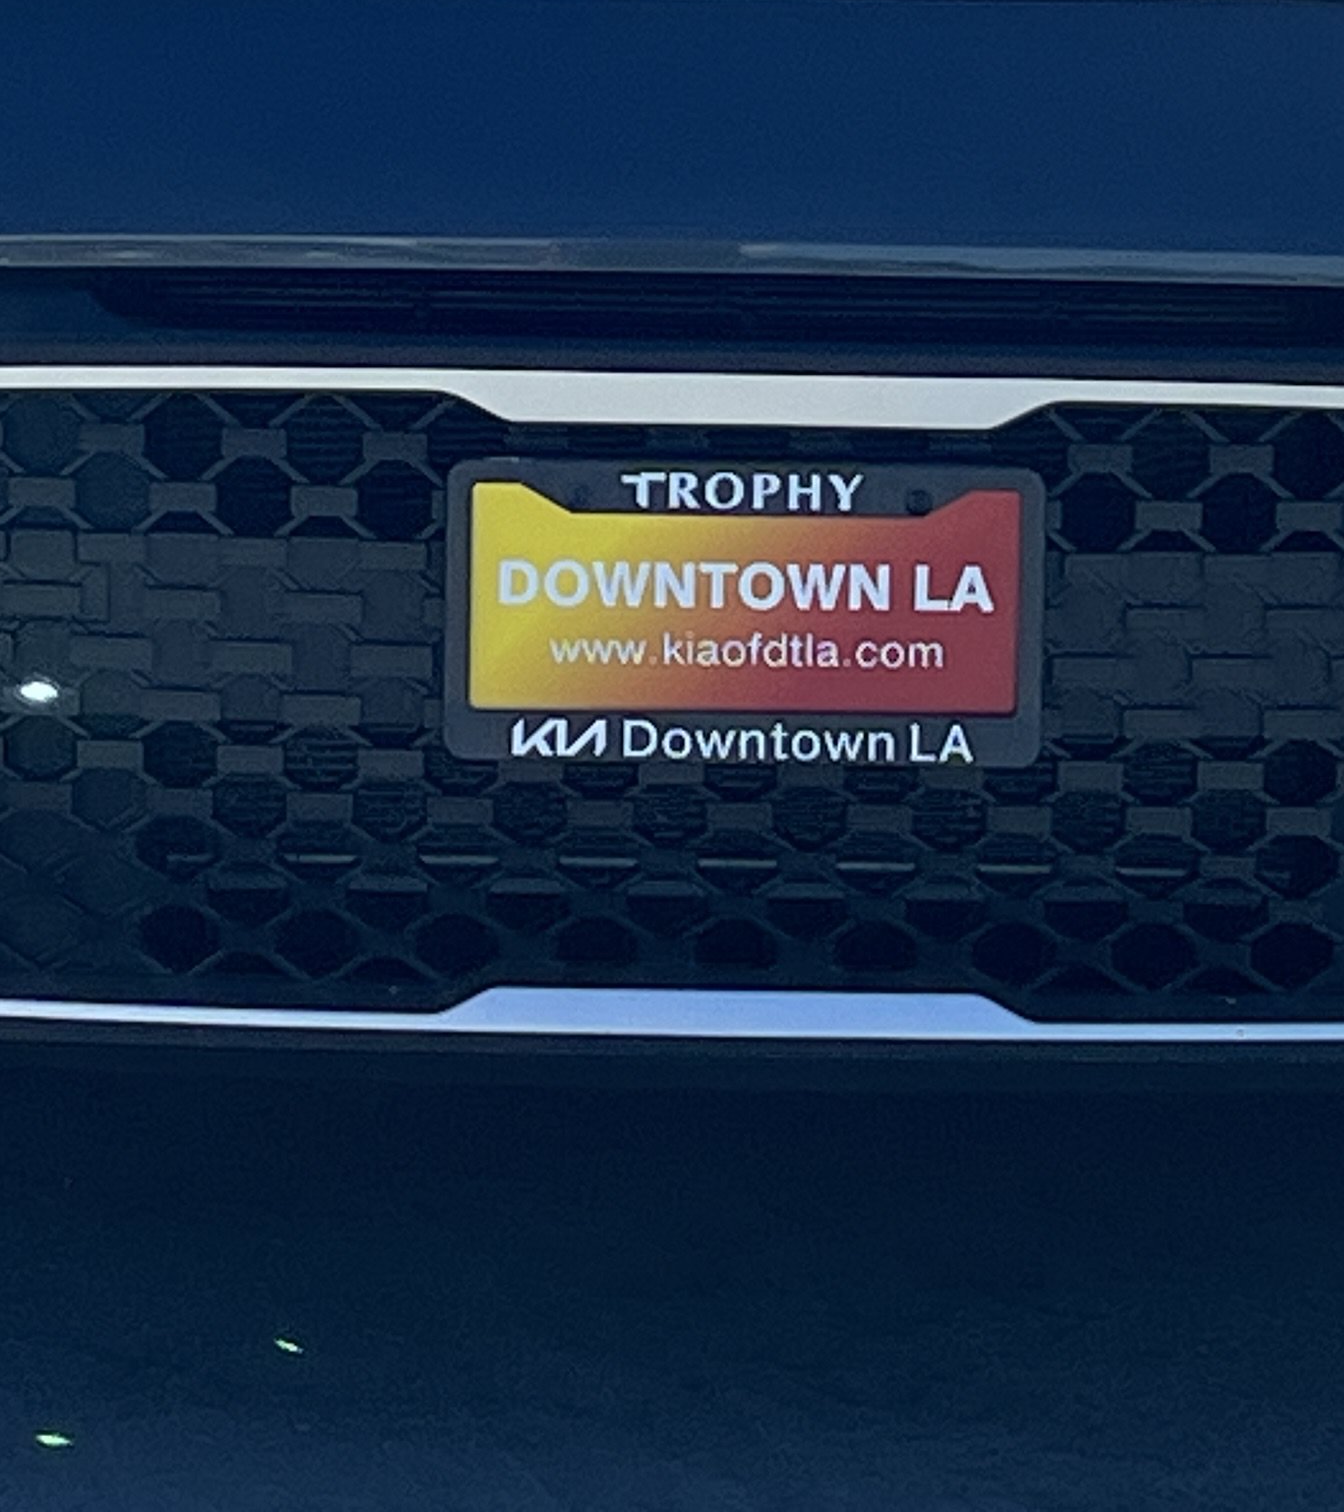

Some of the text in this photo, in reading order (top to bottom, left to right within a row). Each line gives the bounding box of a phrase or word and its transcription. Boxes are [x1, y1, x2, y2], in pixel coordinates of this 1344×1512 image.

[621, 471, 864, 511] TROPHY
[498, 558, 995, 614] DOWNTOWN LA
[549, 632, 944, 669] www.kiaofdtla.com
[510, 718, 974, 764] KIA Downtown LA
